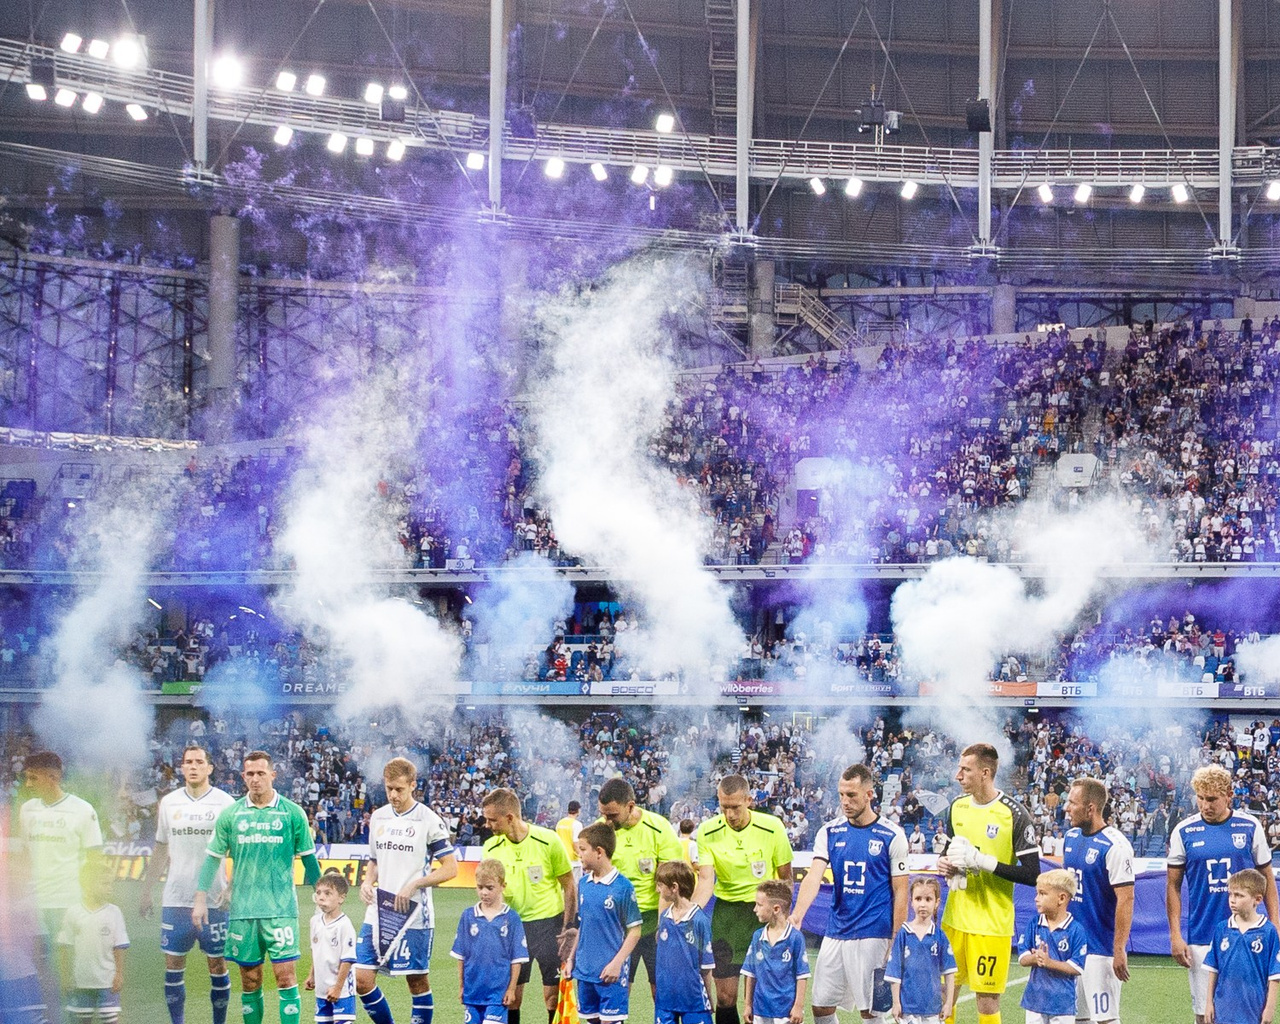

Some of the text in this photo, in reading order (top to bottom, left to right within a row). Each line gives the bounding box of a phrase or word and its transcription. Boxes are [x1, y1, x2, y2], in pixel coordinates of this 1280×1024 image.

[611, 685, 656, 694] BOSCO
[720, 683, 773, 693] wildberries
[1061, 686, 1082, 695] ВТБ
[1182, 686, 1203, 695] ВТБ
[1243, 686, 1265, 696] ВТБ
[172, 826, 214, 836] BetBoom
[237, 834, 283, 844] BetBoom
[375, 840, 414, 853] BetBoom
[210, 923, 227, 942] 55
[274, 927, 294, 947] 99
[976, 955, 997, 977] 67
[1092, 992, 1109, 1014] 10
